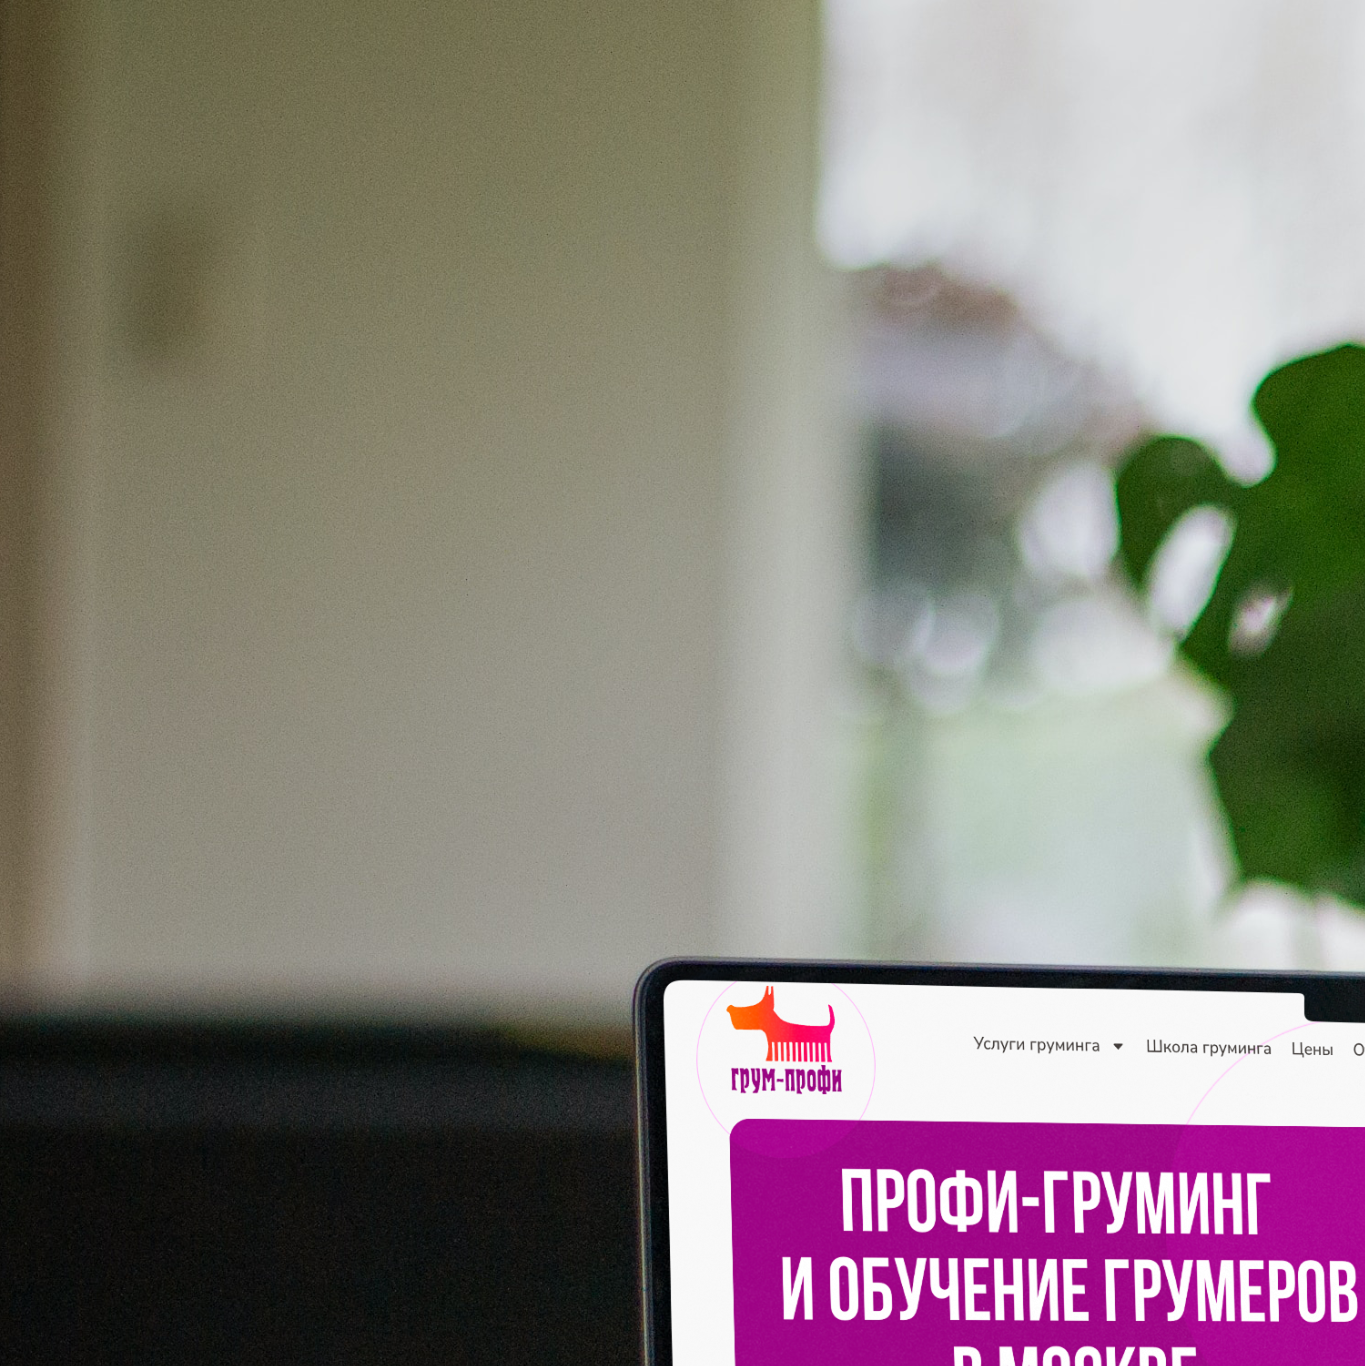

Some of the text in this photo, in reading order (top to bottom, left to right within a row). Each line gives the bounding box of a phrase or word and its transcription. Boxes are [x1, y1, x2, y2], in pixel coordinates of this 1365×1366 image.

[973, 1036, 1100, 1055] Услуги груминга
[1146, 1039, 1272, 1057] Школа груминга
[1291, 1041, 1334, 1058] Цены
[730, 1064, 843, 1095] грум-профи
[841, 1168, 1271, 1236] ПРОФИ-ГРУМИНГ
[781, 1256, 1358, 1323] И ОБУЧЕНИЕ ГРУМЕРОВ
